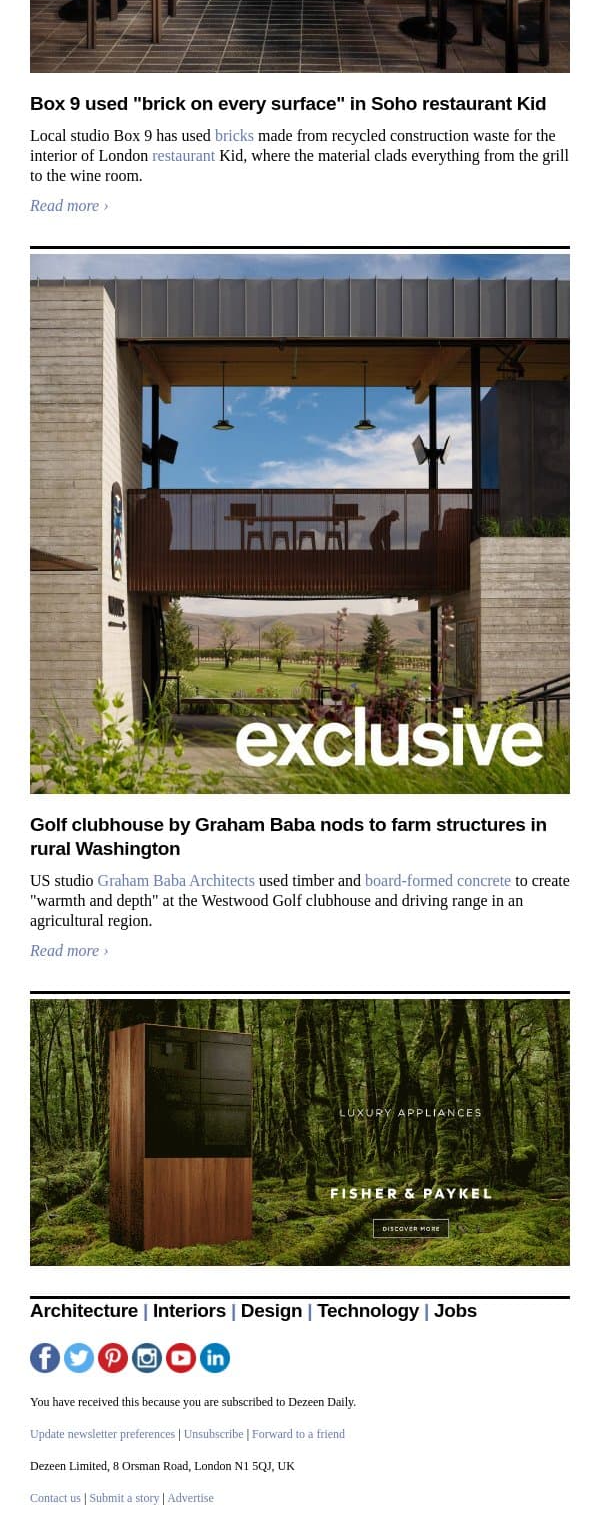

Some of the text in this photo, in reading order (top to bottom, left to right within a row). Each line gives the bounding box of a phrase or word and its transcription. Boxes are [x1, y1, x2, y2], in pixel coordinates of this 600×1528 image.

[30, 96, 547, 115] Box 9 used "brick on every surface" in Soho restaurant Kid
[29, 168, 143, 183] to the wine room.
[29, 816, 547, 836] Golf clubhouse by Graham Baba nods to farm structures in
[30, 840, 181, 860] rural Washington
[29, 913, 153, 931] agricultural region.
[339, 1108, 482, 1118] LUXURY APPLIANCES
[330, 1188, 492, 1199] FISHER & PAYKEL
[29, 1302, 478, 1322] Architecture Interiors Design Technology Jobs
[29, 1395, 357, 1410] You have received this because you are subscribed to Dezeen Daily.
[30, 1428, 345, 1442] Update newsletter preferences Unsubscribe Forward to a friend
[29, 1459, 296, 1473] Dezeen Limited, 8 Orsman Road, London N1 5QJ, UK
[29, 1491, 215, 1506] Contact us Submit a story Advertise
